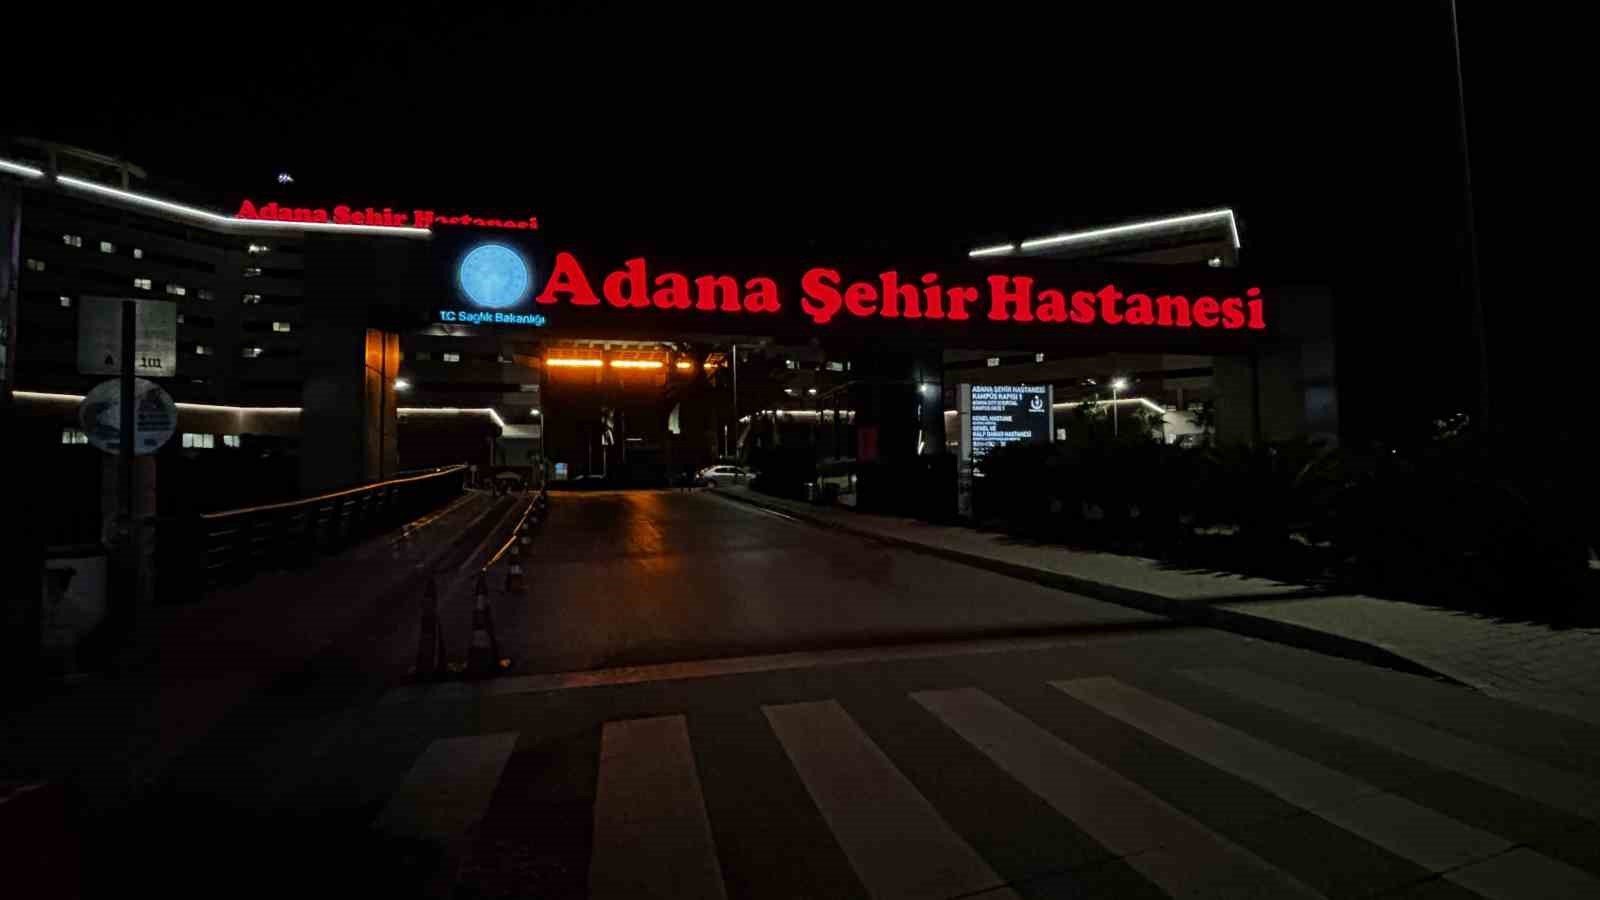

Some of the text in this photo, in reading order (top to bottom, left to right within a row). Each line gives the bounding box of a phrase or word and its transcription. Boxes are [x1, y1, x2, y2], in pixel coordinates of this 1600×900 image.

[235, 200, 328, 222] Adana
[536, 252, 1265, 330] Adana Şehir Hastanesi
[972, 385, 993, 393] ADANA
